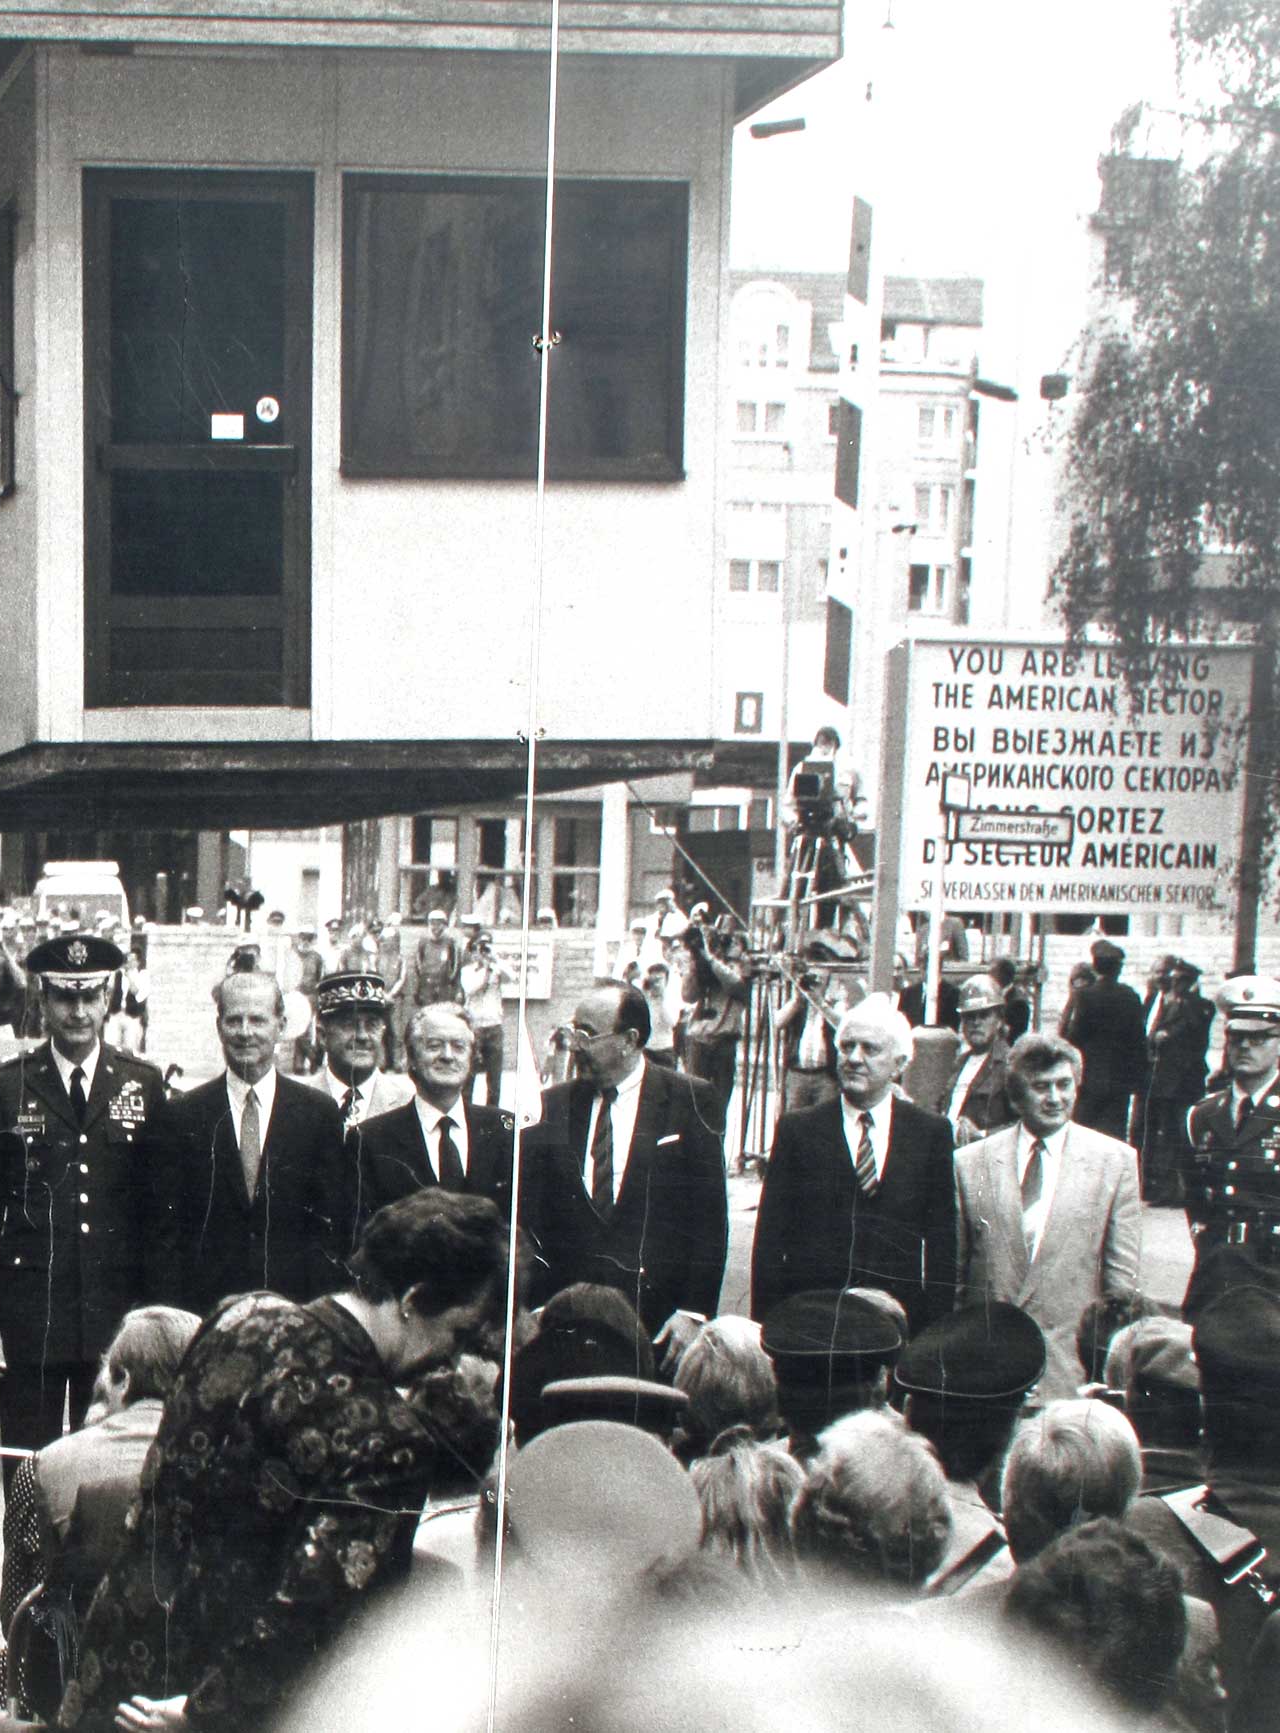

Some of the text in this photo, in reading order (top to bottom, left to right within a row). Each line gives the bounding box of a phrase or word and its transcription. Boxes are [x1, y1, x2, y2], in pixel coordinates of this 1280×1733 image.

[948, 648, 1210, 682] YOU ARE LEVNG
[932, 682, 975, 709] THE
[987, 684, 1117, 713] AMERICAN
[933, 726, 976, 753] ВЫ
[992, 728, 1162, 758] ВЫЕЗЖАЕТЕ
[1124, 765, 1221, 793] СЕКТОРА
[970, 815, 1059, 838] Zimmerstraße
[943, 881, 1017, 902] VERLASSEN
[1019, 882, 1045, 903] DEN
[1049, 882, 1162, 904] AMERIKANISCHEN
[1166, 885, 1216, 905] SEKTOR
